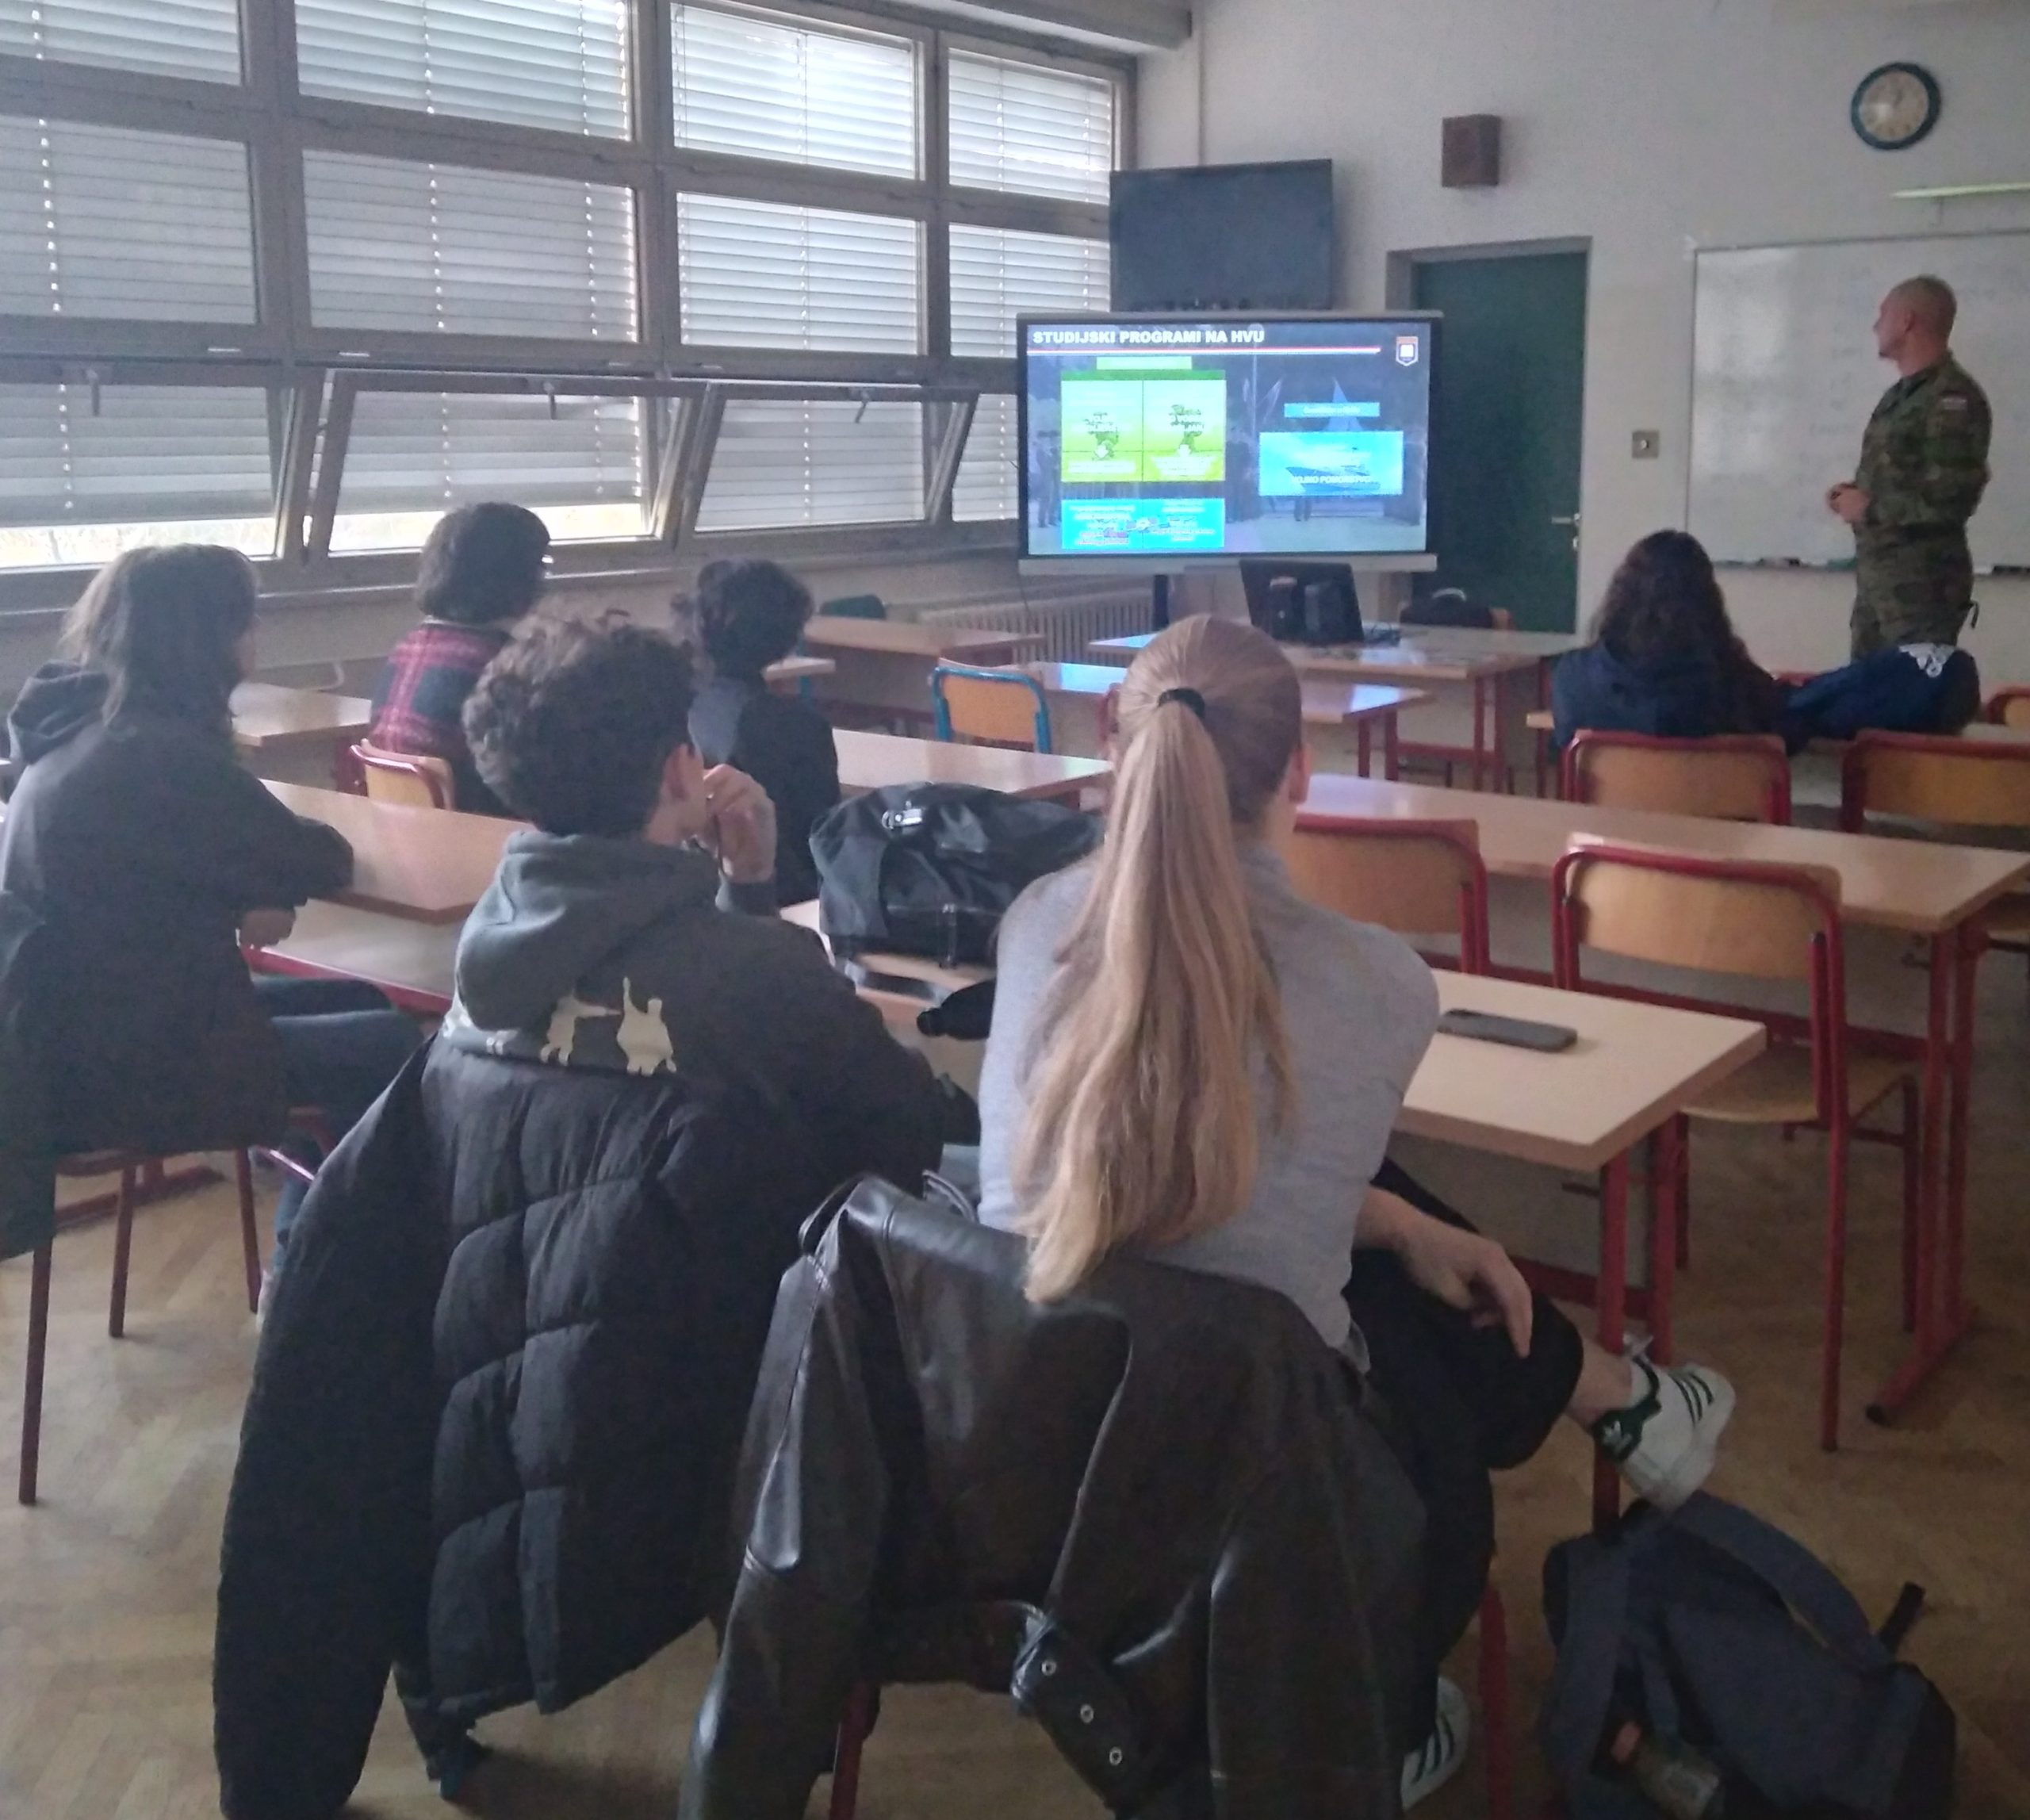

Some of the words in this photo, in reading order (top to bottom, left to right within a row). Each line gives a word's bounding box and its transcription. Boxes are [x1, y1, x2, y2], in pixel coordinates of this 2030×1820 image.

[1032, 331, 1116, 343] STUDIJSKI
[1119, 331, 1201, 343] PROGRAMI
[1205, 330, 1228, 343] NA
[1231, 330, 1266, 343] HVU
